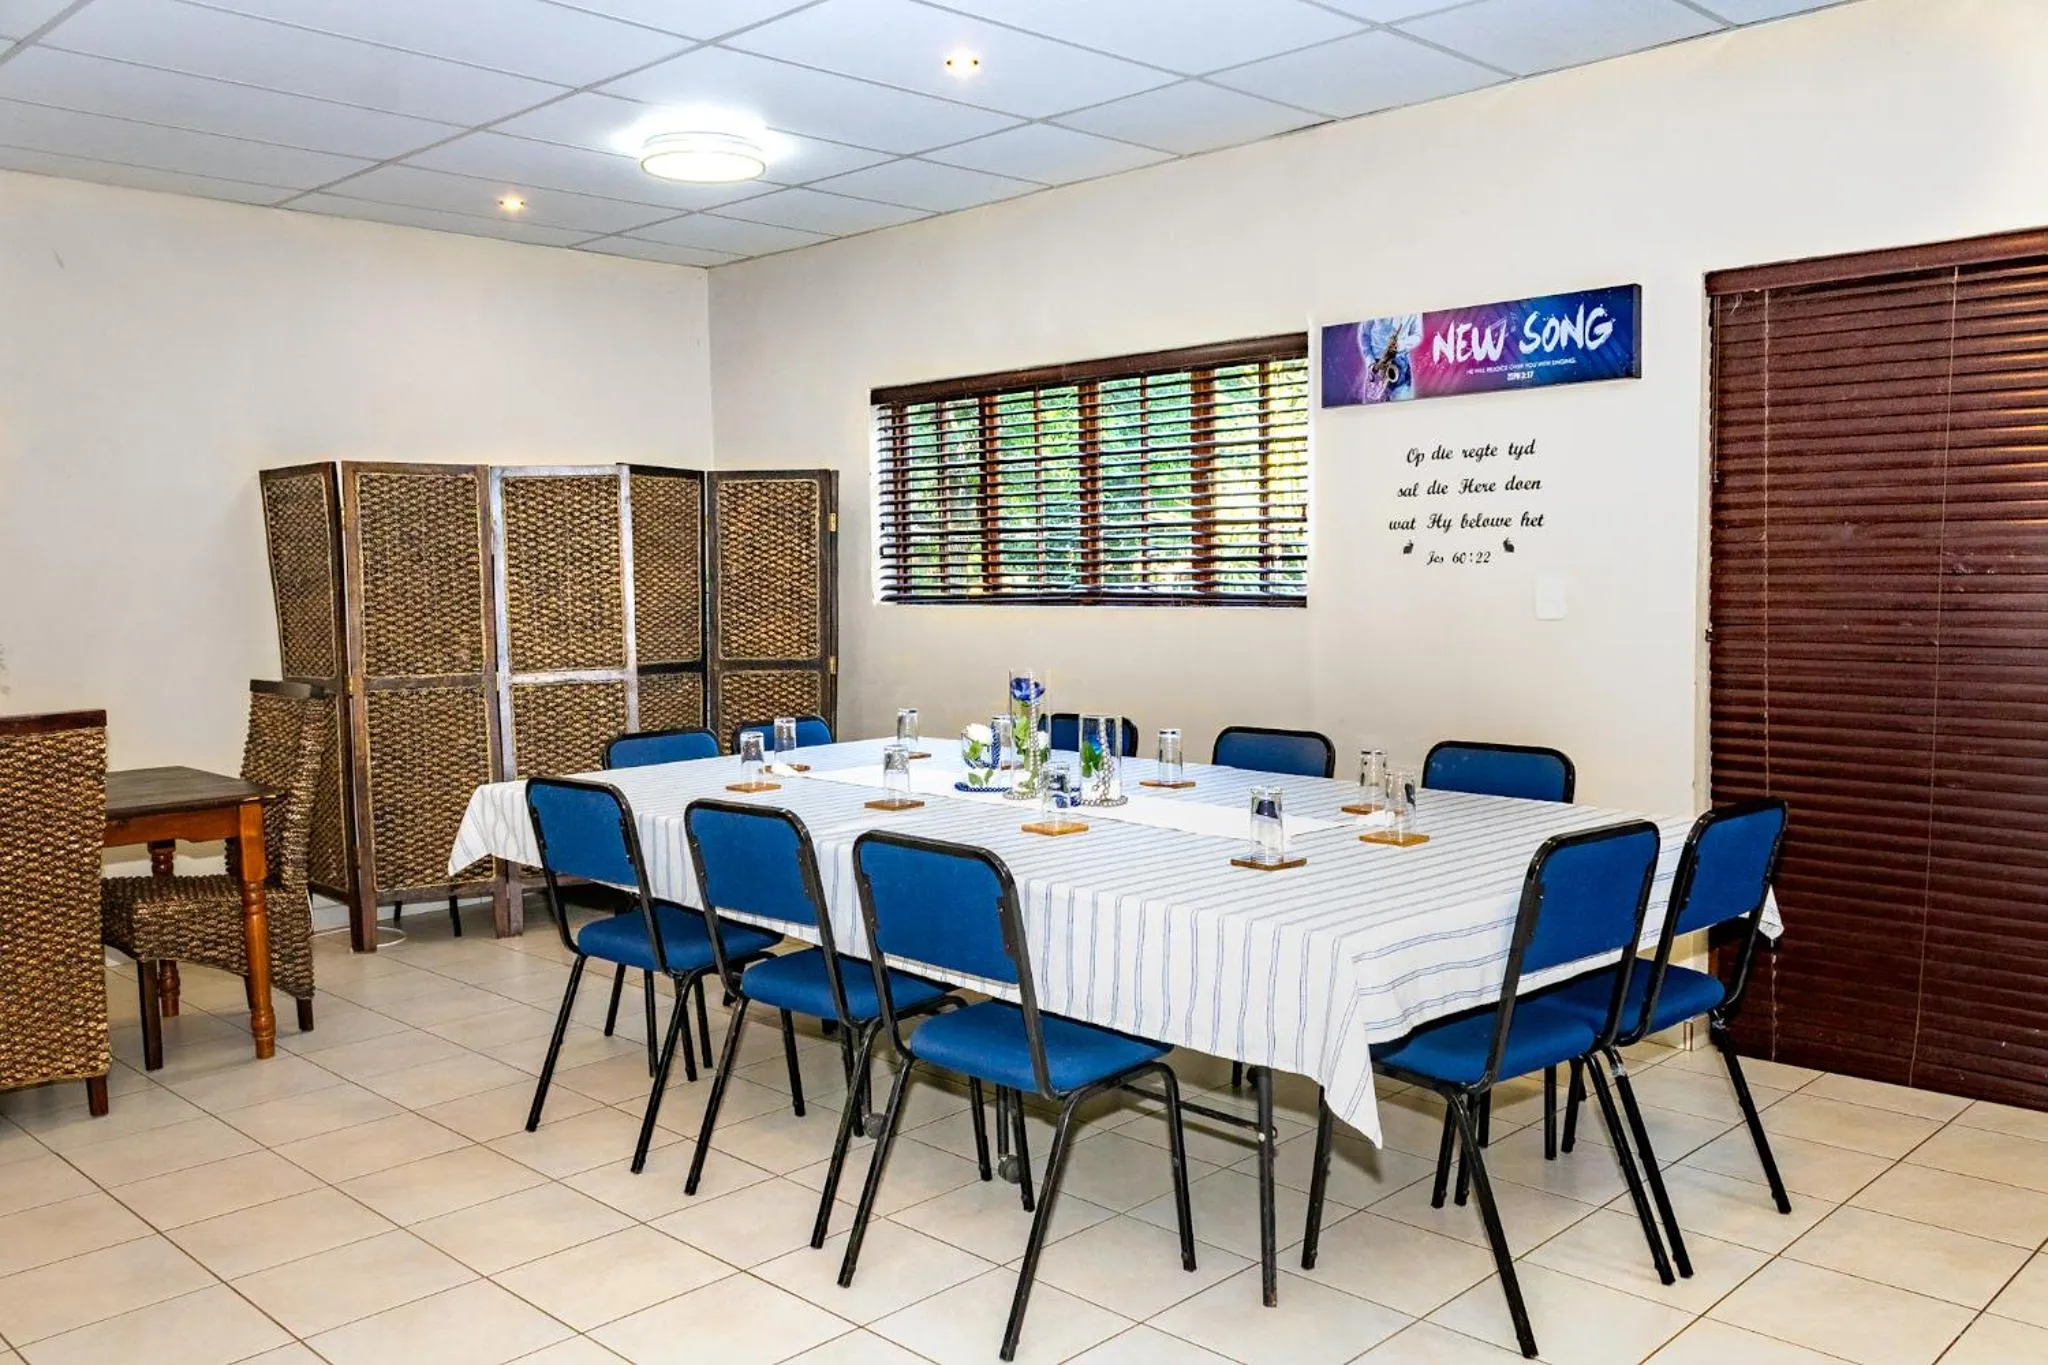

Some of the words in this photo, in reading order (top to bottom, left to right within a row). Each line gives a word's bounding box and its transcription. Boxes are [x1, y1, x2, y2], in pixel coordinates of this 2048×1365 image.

[1433, 320, 1507, 364] NEW
[1519, 304, 1615, 354] SONG
[1406, 447, 1425, 467] Op
[1431, 444, 1454, 460] die
[1462, 443, 1498, 463] regte
[1508, 438, 1536, 461] tyd
[1397, 482, 1420, 498] sal
[1427, 479, 1449, 495] die
[1458, 477, 1497, 495] Here
[1504, 474, 1542, 491] doen
[1389, 517, 1416, 530] wat
[1426, 512, 1452, 534] Hy
[1460, 512, 1513, 529] belowe
[1520, 510, 1545, 528] het
[1426, 550, 1445, 566] Jes
[1451, 551, 1492, 564] 60:22
